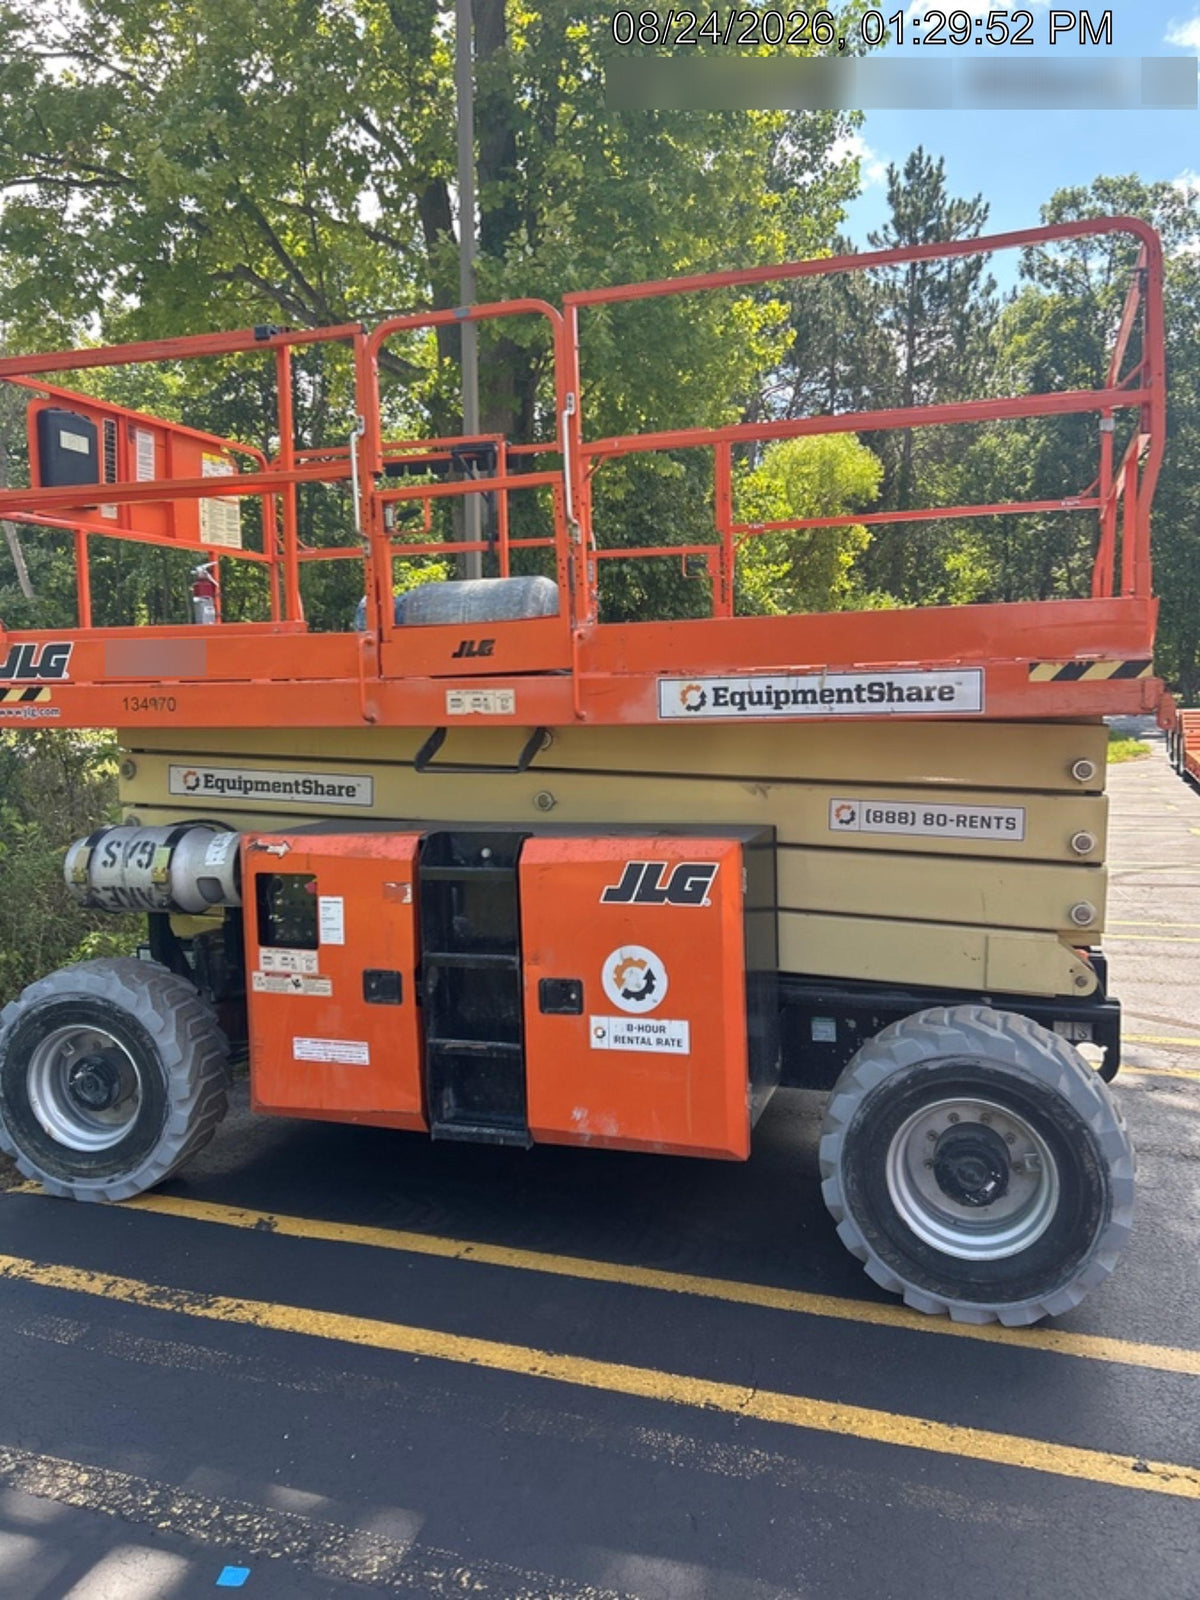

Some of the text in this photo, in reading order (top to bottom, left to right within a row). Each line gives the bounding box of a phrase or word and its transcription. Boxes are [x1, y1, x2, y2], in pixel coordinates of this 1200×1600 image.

[452, 639, 496, 658] JLG
[0, 642, 74, 680] JLG
[712, 682, 955, 711] EquipmentShare
[203, 774, 357, 798] EquipmentShare
[865, 808, 1017, 830] (888) 80-RENTS
[600, 861, 720, 907] JLG
[613, 1034, 684, 1048] RENTAL RATE
